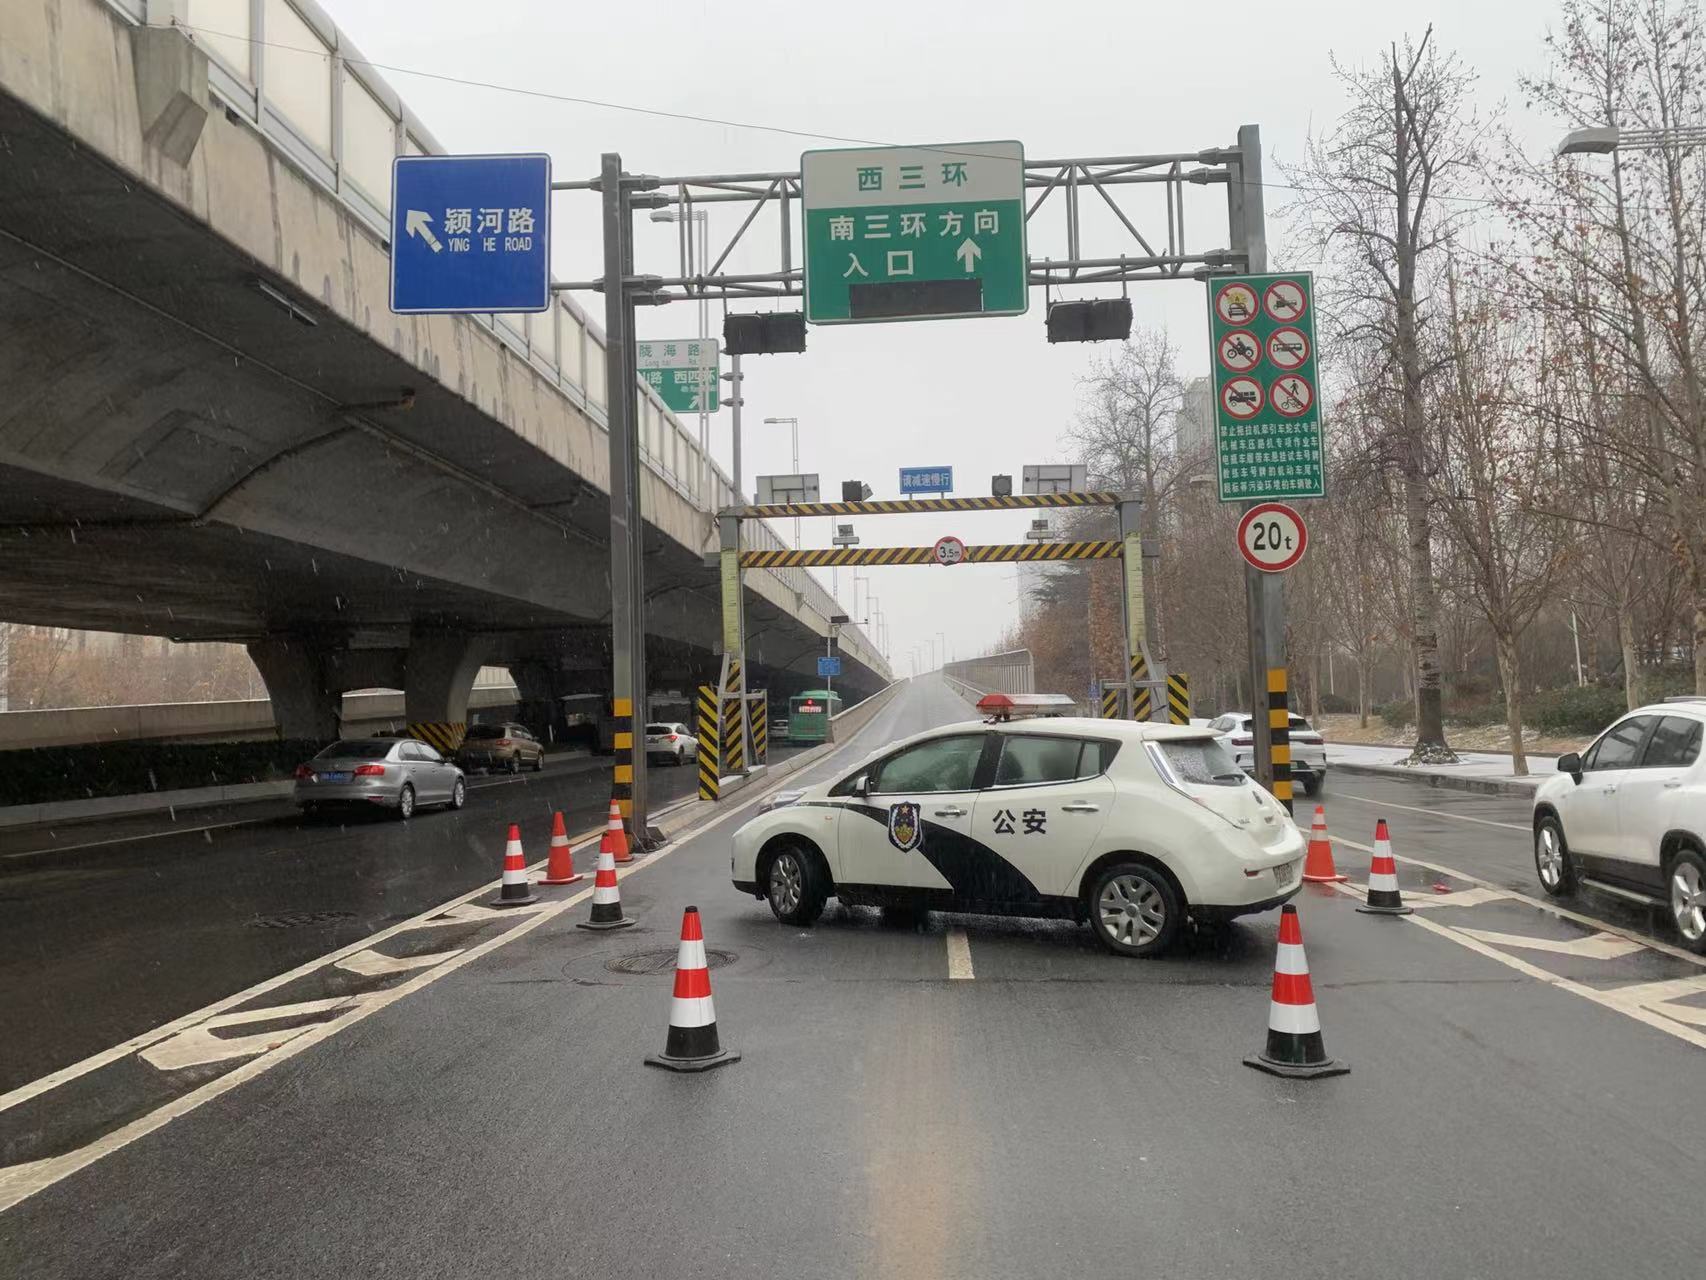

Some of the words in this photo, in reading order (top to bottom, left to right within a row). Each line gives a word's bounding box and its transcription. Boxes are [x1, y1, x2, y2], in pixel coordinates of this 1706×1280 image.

[857, 162, 968, 191] 西三环
[829, 209, 1000, 241] 南三环方向
[448, 238, 471, 252] YING
[483, 238, 496, 252] HE
[505, 237, 532, 252] ROAD
[842, 250, 914, 278] 入口
[639, 343, 700, 358] 陇海路
[993, 808, 1047, 835] 公安
